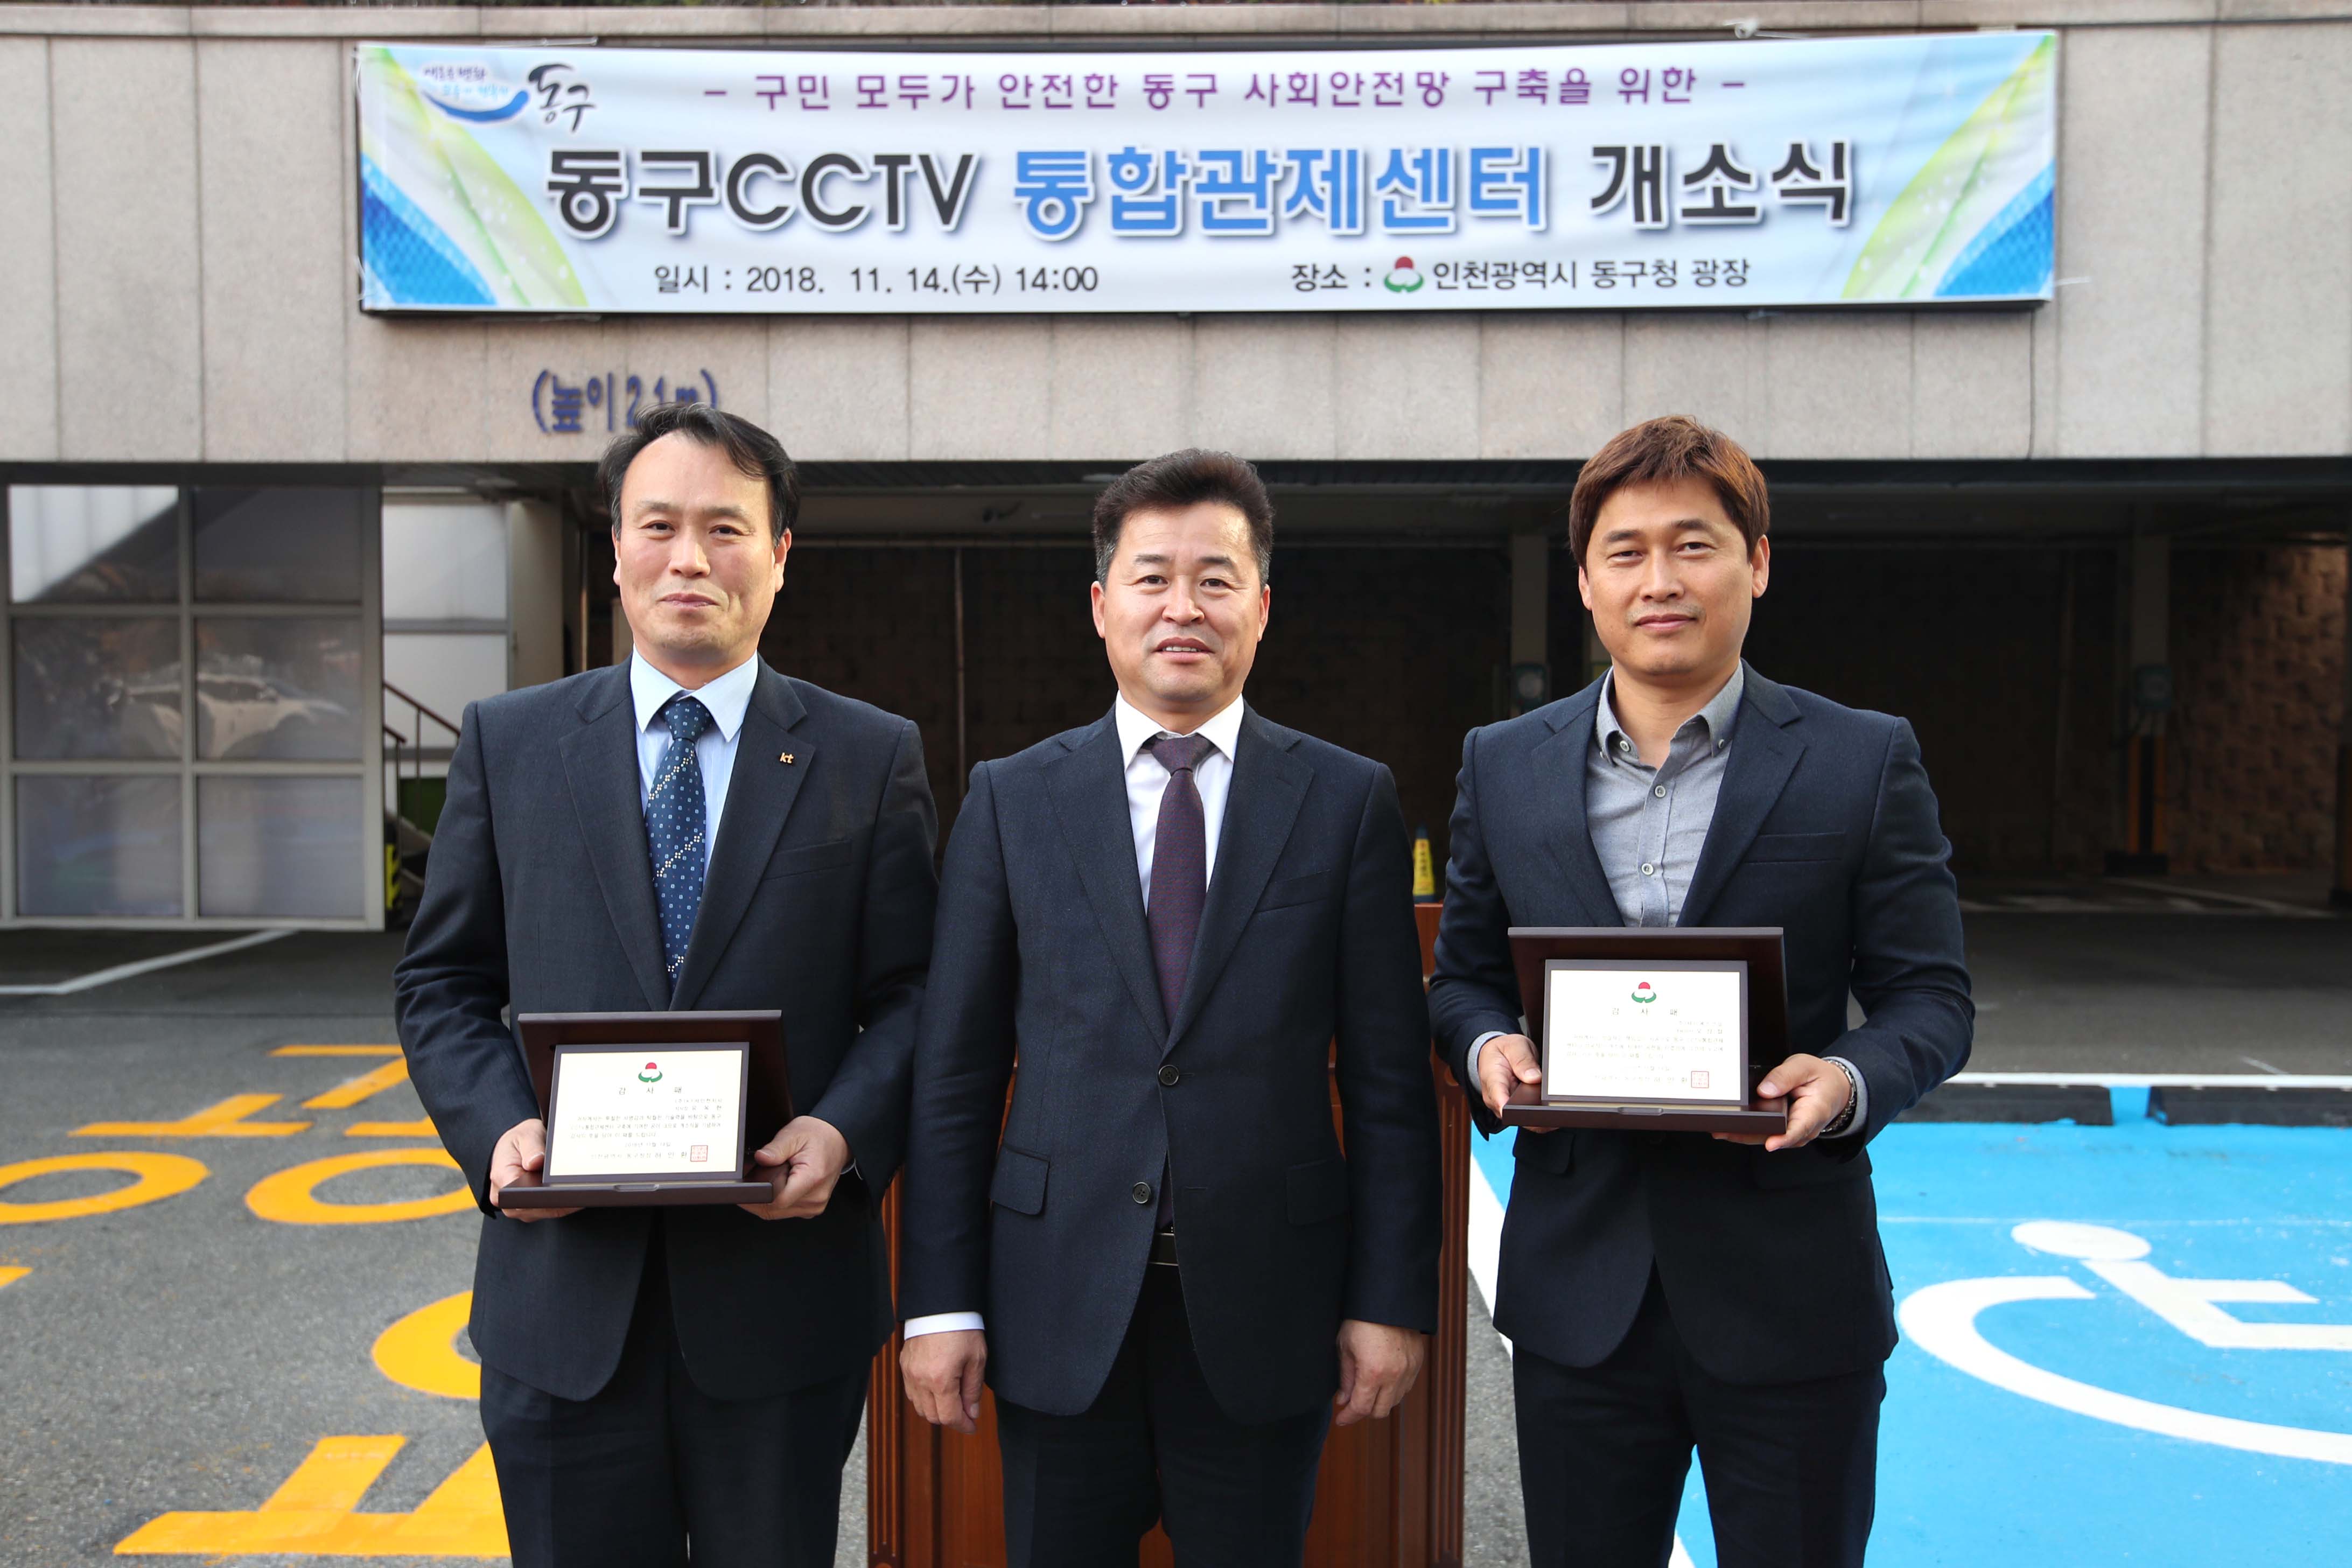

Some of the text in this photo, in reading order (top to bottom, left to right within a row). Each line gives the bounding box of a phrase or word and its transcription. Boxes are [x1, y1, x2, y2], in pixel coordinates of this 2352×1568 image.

[528, 63, 596, 132] 동구
[756, 76, 830, 111] 구민
[857, 75, 975, 110] 모두가
[999, 74, 1119, 110] 안전한
[1143, 74, 1218, 111] 동구
[1245, 72, 1450, 109] 사회안전망
[1475, 68, 1592, 106] 구축을
[1618, 67, 1697, 104] 위한
[548, 142, 1849, 238] 동구CCTV 통합관제센터 개소식
[655, 266, 708, 294] 일시
[747, 267, 824, 293] 2018.
[851, 268, 892, 293] 11.
[908, 265, 1001, 294] 14.(수)
[1017, 267, 1099, 292] 14:00
[1292, 264, 1348, 293] 장소
[1433, 262, 1577, 290] 인천광역시
[1591, 261, 1678, 289] 동구청
[1692, 260, 1750, 288] 광장
[779, 752, 794, 764] kt
